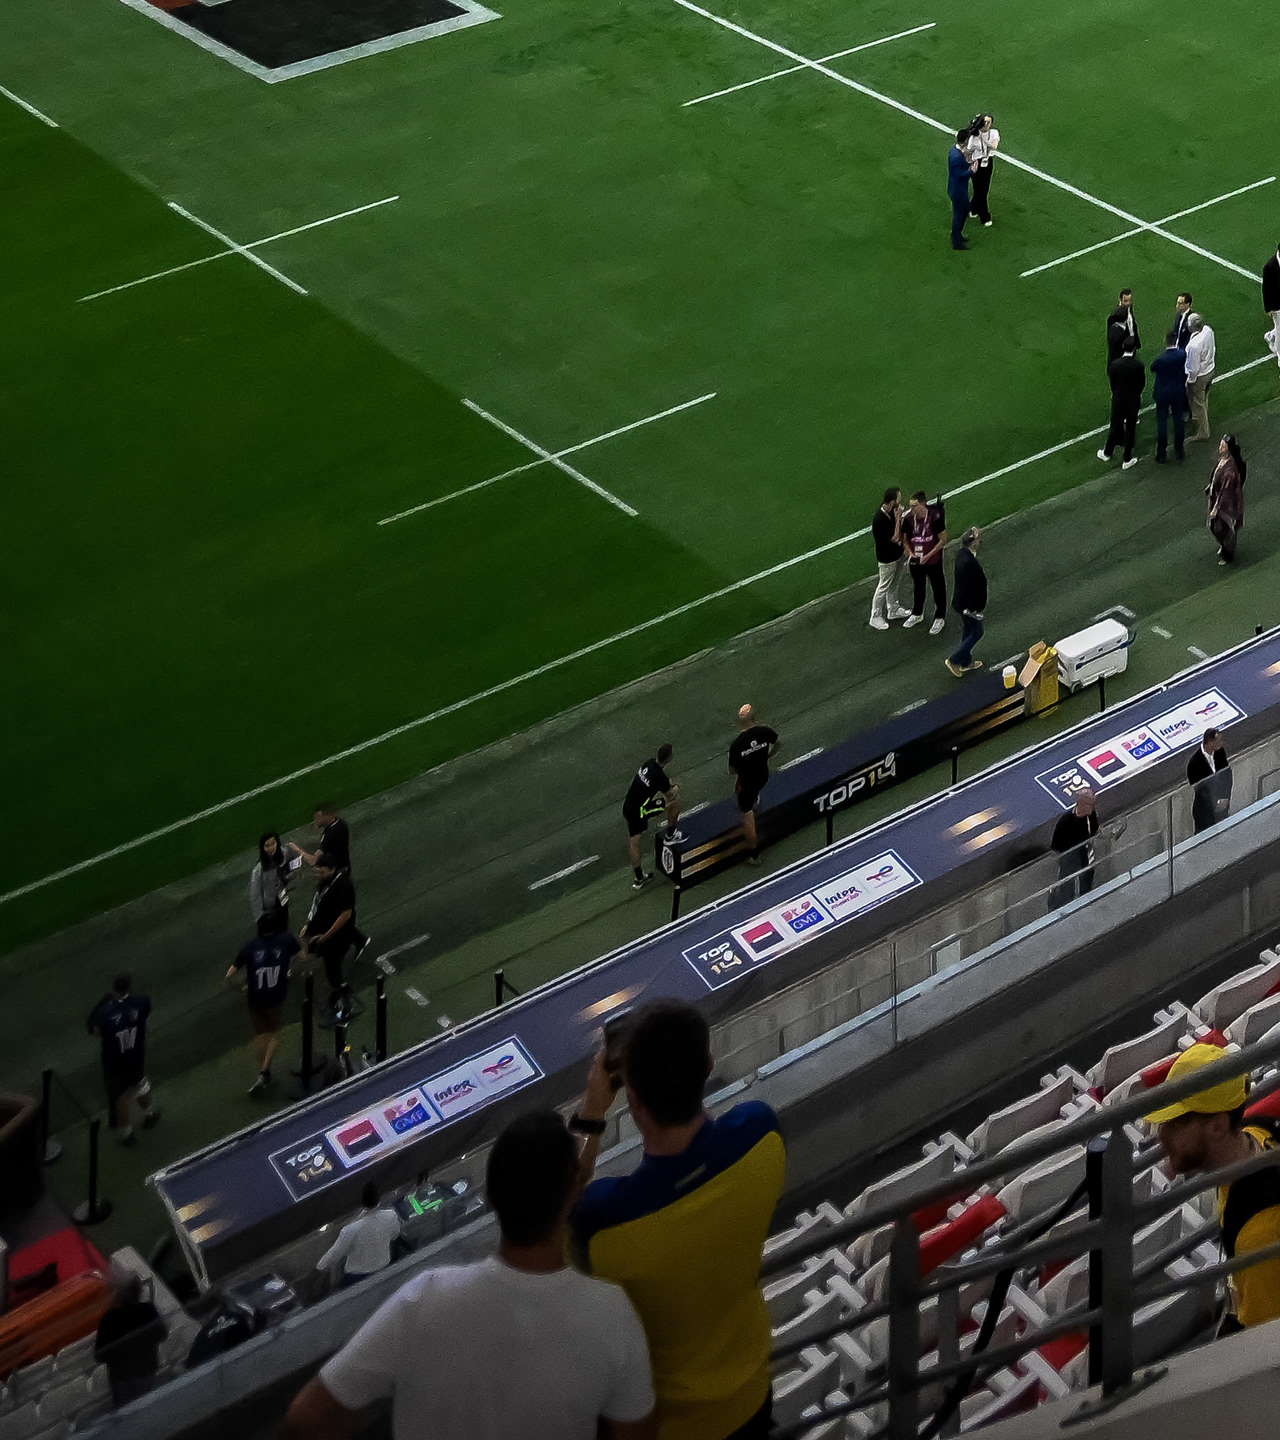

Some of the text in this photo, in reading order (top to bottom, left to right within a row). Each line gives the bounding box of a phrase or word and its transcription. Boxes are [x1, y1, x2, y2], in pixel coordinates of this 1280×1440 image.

[1132, 741, 1155, 758] GMF
[813, 760, 896, 812] TOP14
[1050, 768, 1078, 785] TOP
[792, 910, 818, 930] GMF
[698, 942, 731, 962] TOP
[711, 954, 742, 975] 14
[256, 965, 281, 989] TV
[395, 1109, 424, 1131] GMF
[285, 1143, 323, 1167] TOP
